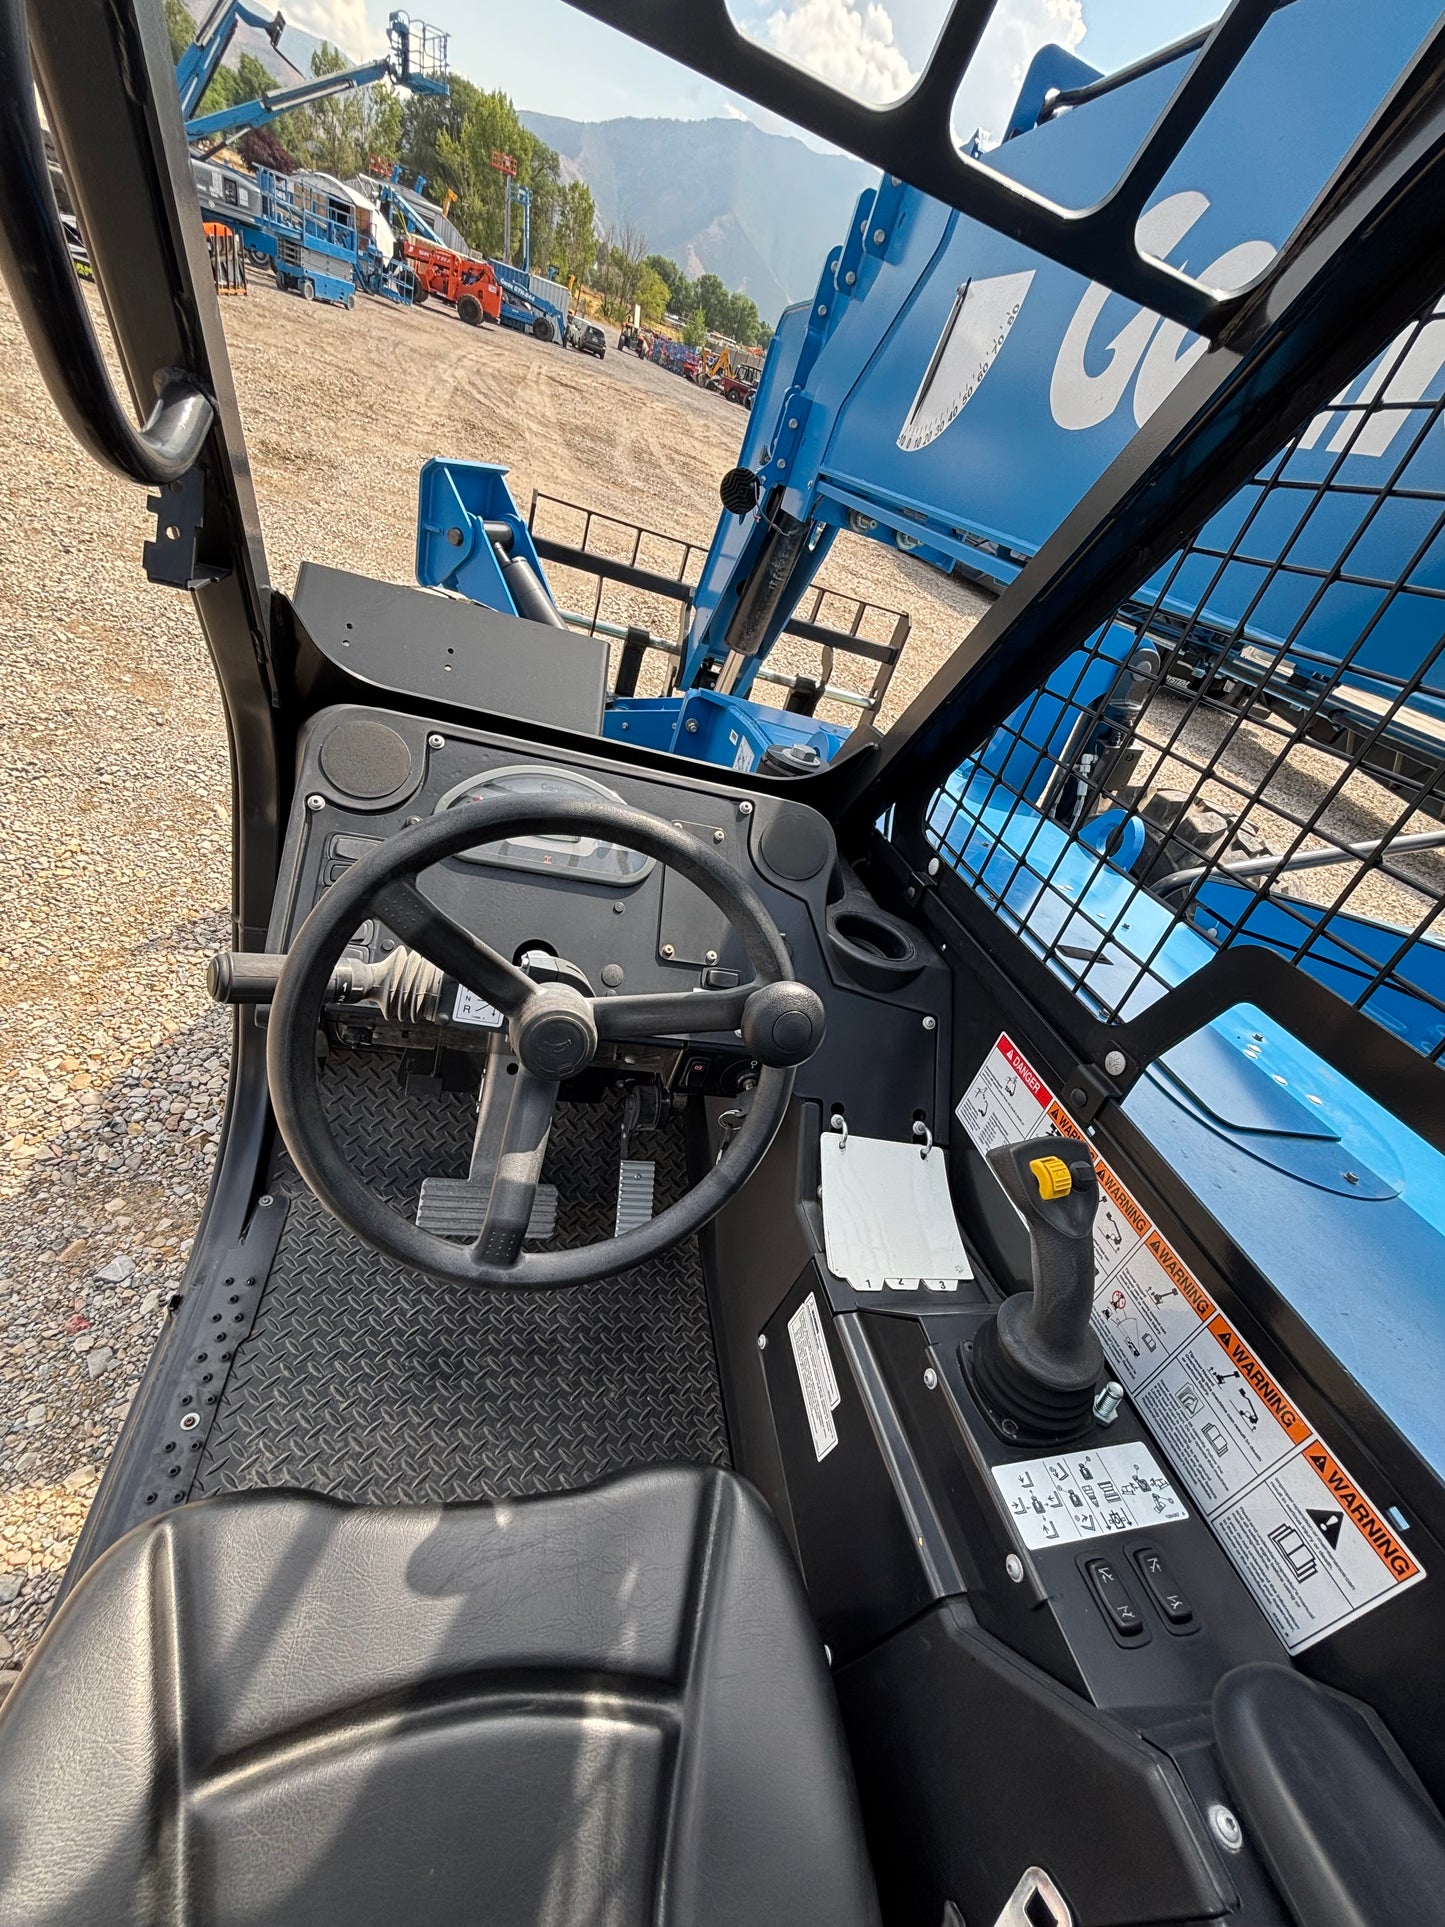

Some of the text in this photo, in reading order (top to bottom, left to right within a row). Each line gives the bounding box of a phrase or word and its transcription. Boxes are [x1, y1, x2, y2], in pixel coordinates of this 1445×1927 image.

[1007, 303, 1020, 325] 80
[992, 334, 1005, 354] 70
[977, 362, 989, 382] 60
[962, 386, 973, 405] 50
[947, 406, 958, 422] 40
[922, 431, 933, 445] 20
[935, 422, 945, 436] 30
[463, 1005, 471, 1014] R
[1013, 1056, 1040, 1093] DANGER
[1103, 1175, 1147, 1232] WARNING
[866, 1279, 871, 1288] 1
[939, 1280, 946, 1289] 3
[1158, 1247, 1209, 1315] WARNING
[1233, 1344, 1296, 1428] WARNING
[1329, 1470, 1410, 1577] WARNING
